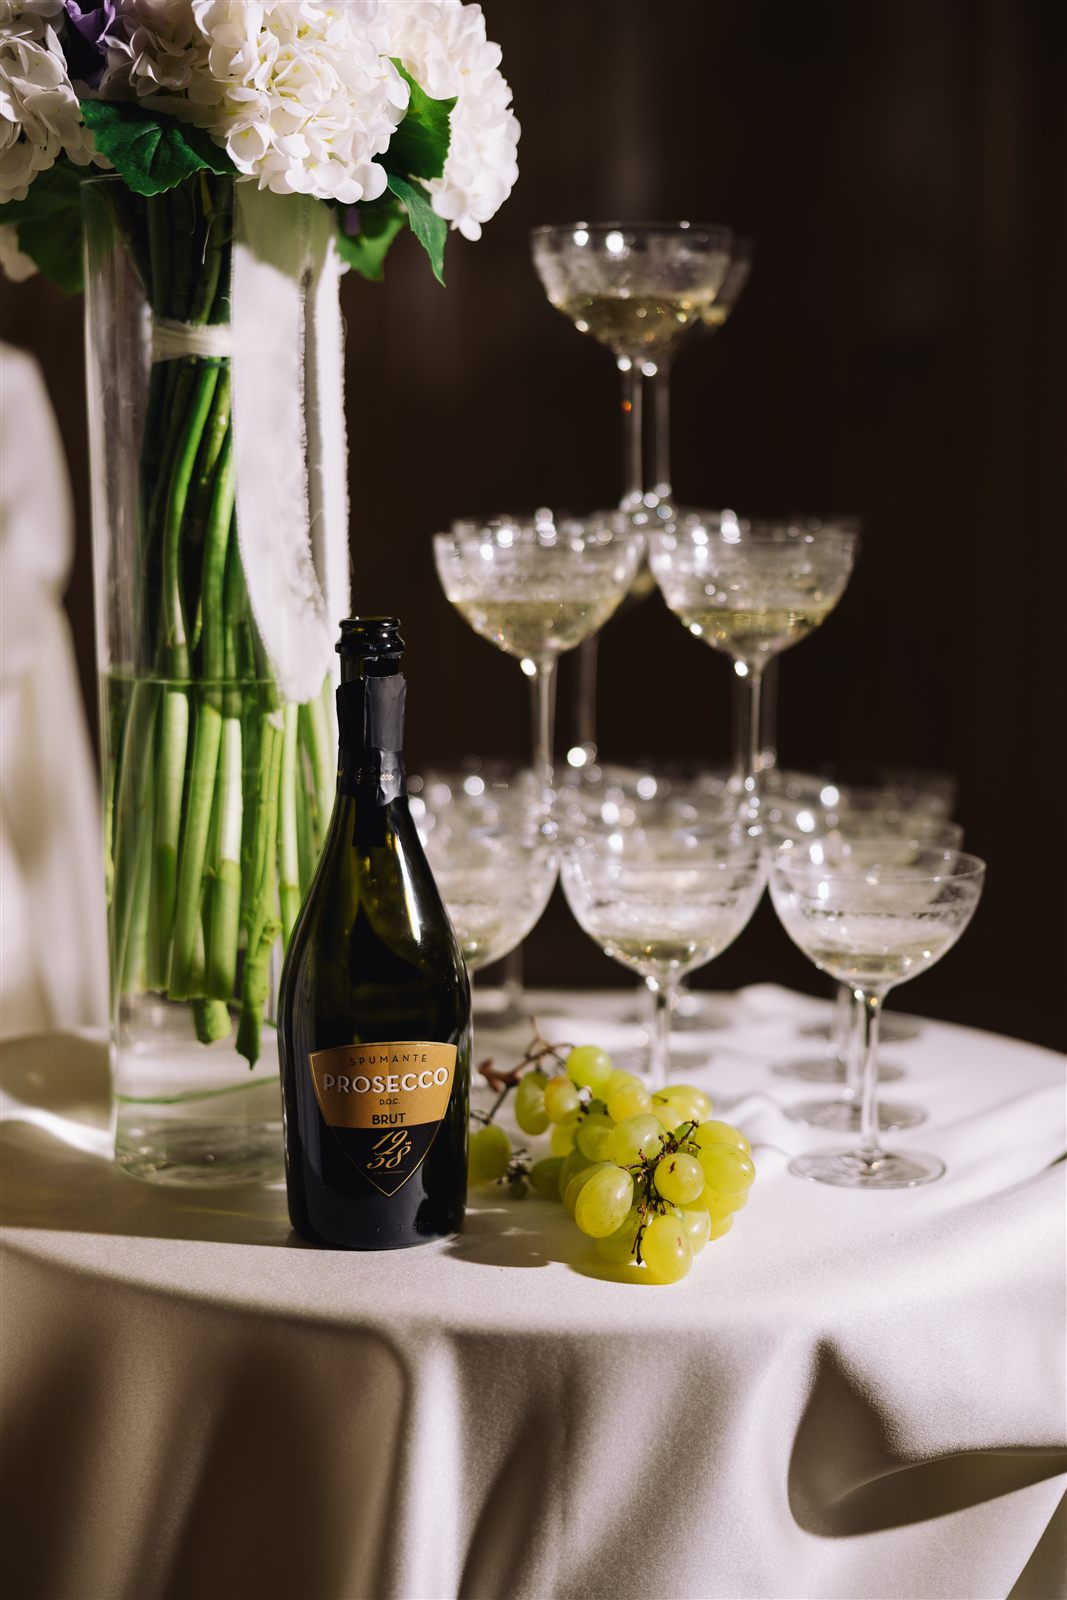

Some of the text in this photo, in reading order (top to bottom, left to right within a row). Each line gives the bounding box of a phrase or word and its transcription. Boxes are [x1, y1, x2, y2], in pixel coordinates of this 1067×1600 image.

[350, 1053, 427, 1065] SPUMANTE
[323, 1067, 449, 1093] PROSECCO
[372, 1112, 406, 1125] BRUT
